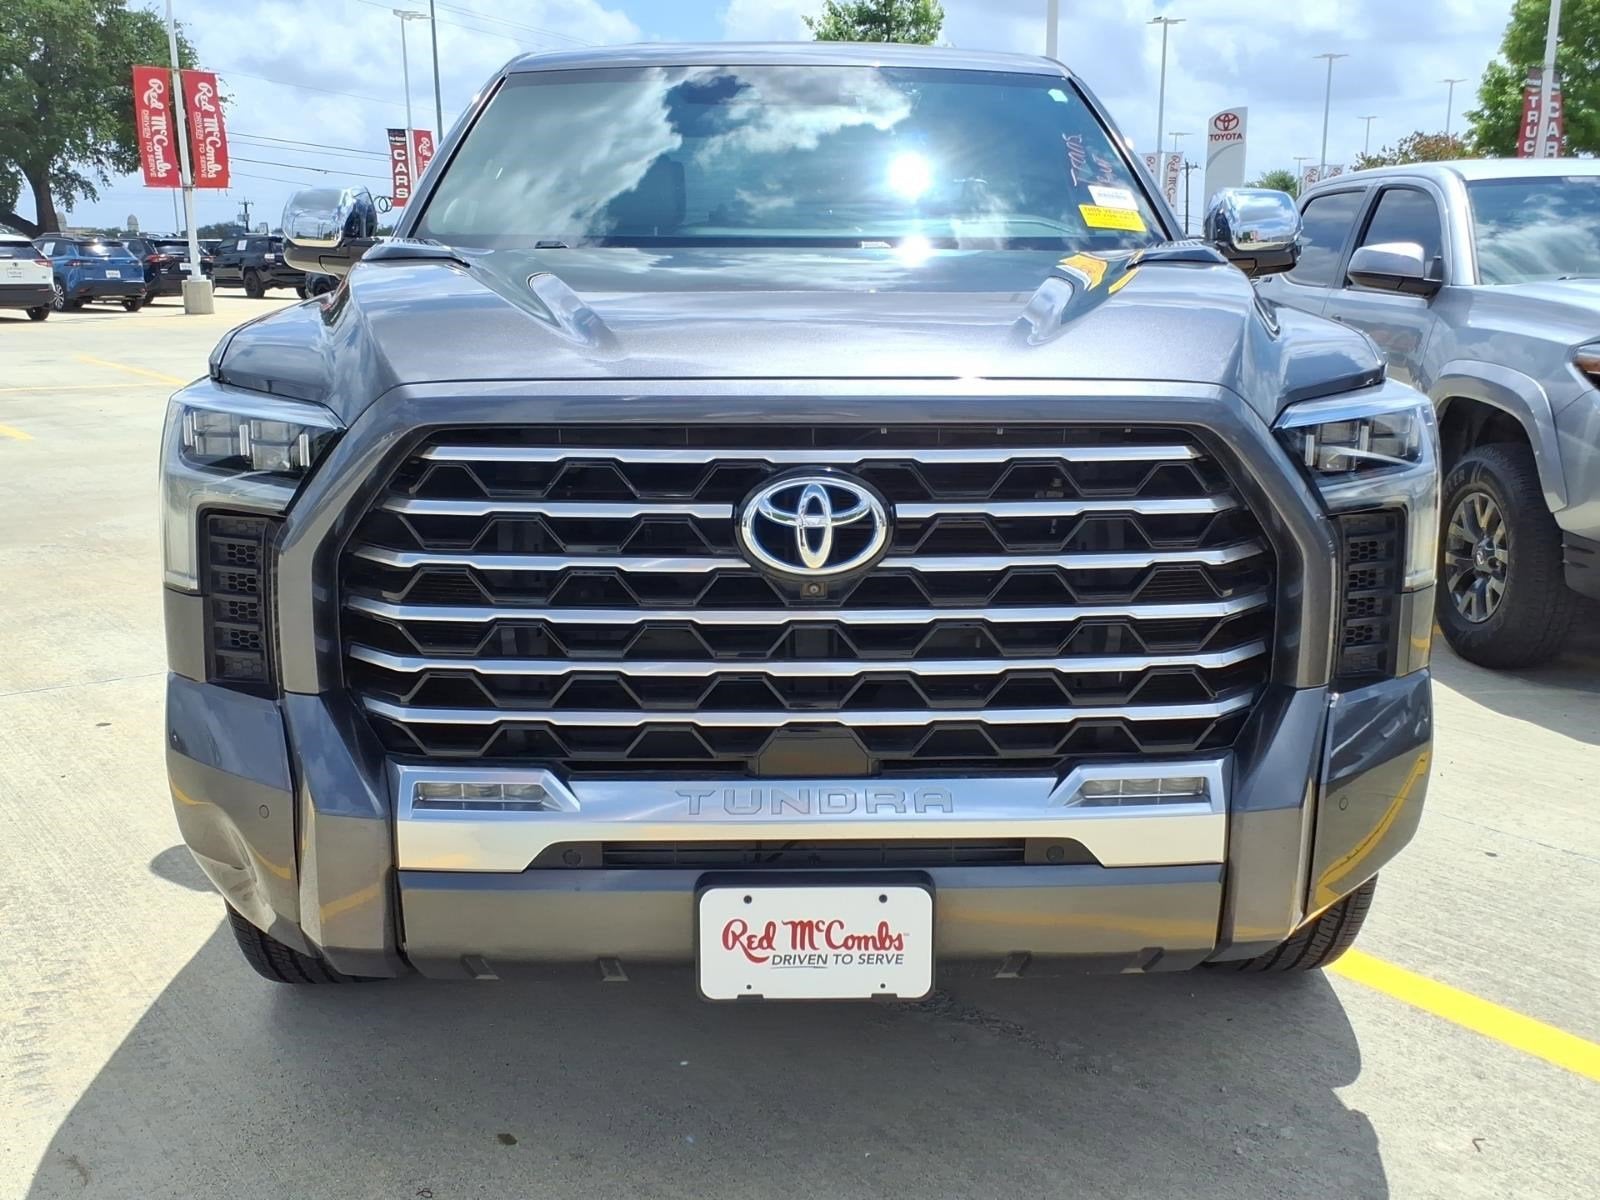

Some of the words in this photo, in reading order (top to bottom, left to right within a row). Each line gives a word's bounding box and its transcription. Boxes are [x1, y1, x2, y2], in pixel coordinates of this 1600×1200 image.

[143, 78, 164, 110] Red
[194, 81, 215, 112] Red
[1209, 132, 1243, 142] TOYOTA
[1524, 96, 1538, 158] TRUC
[146, 141, 153, 153] TO
[151, 112, 171, 177] McCombs
[198, 142, 205, 153] TO
[204, 114, 222, 178] McCombs
[418, 137, 431, 157] Red
[394, 150, 408, 198] CARS
[675, 787, 954, 816] TUNDRA
[722, 918, 779, 964] Red
[781, 919, 905, 951] McCombs
[771, 953, 828, 966] DRIVEN
[832, 953, 854, 965] TO
[857, 953, 905, 965] SERVE
